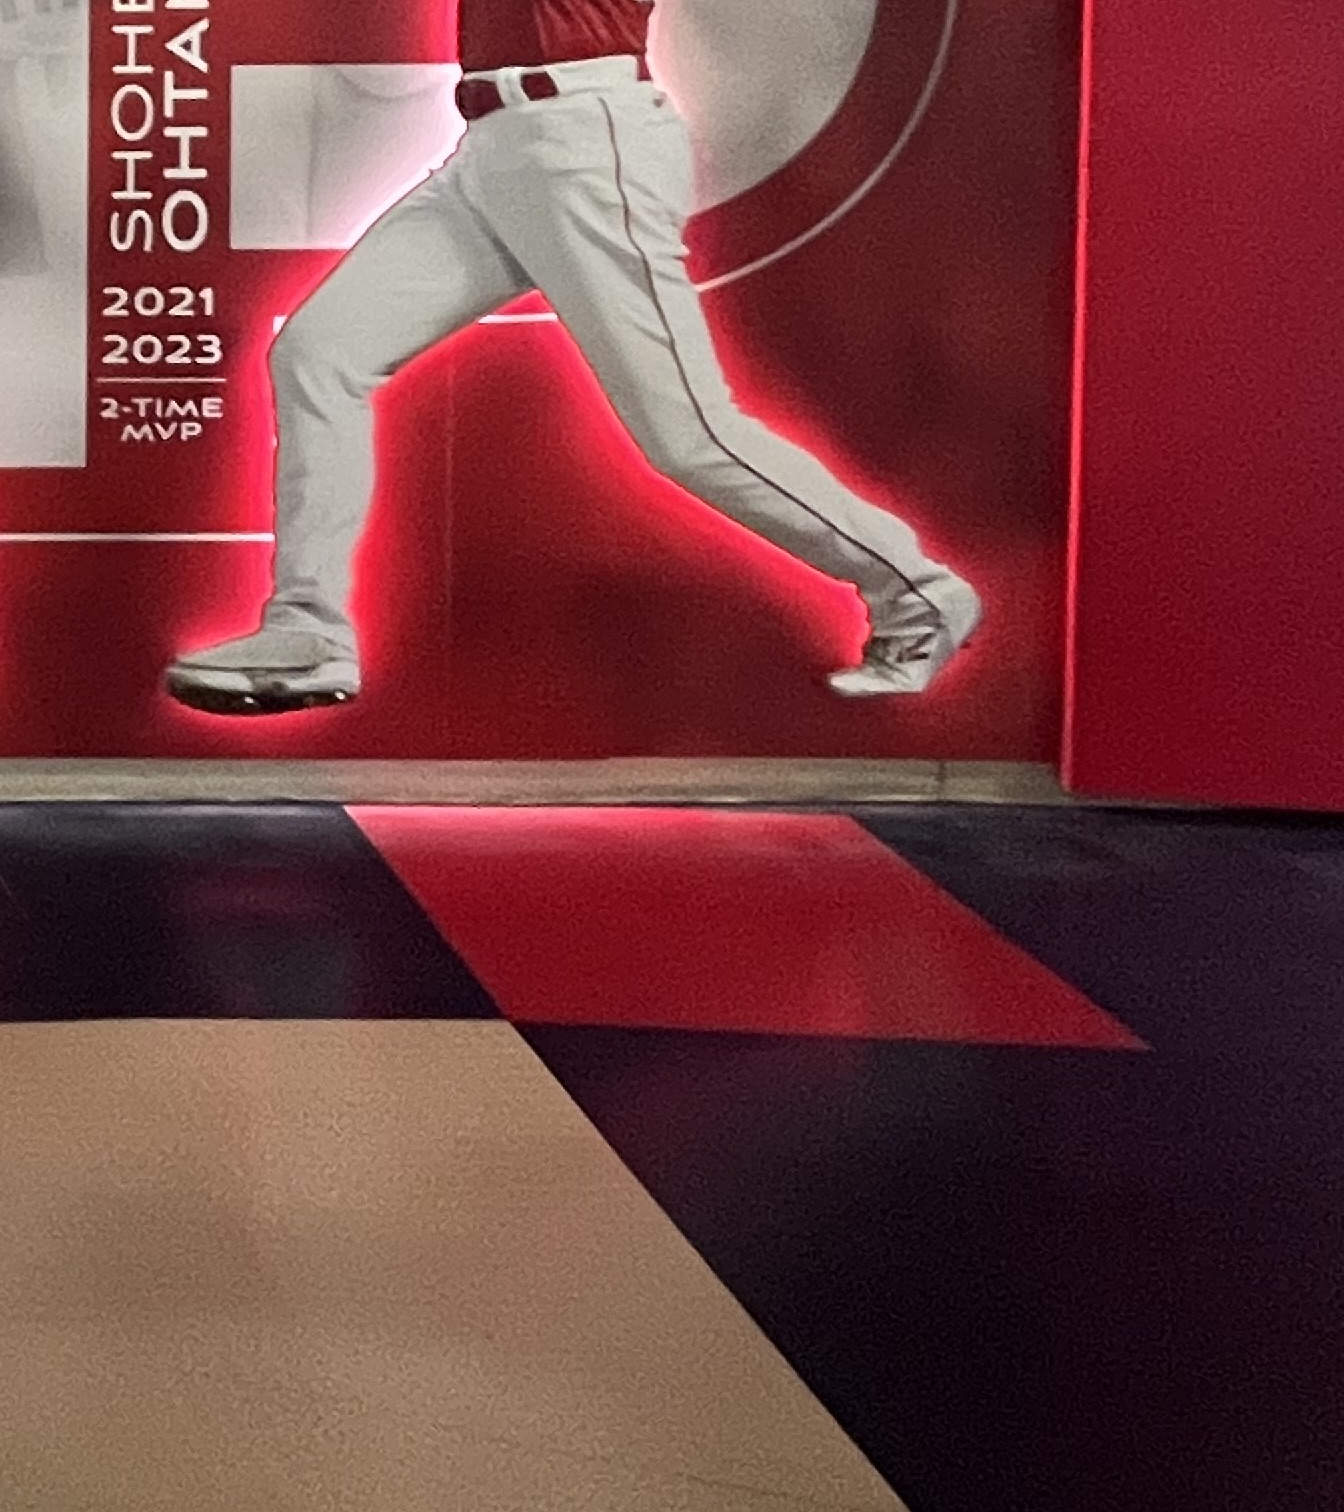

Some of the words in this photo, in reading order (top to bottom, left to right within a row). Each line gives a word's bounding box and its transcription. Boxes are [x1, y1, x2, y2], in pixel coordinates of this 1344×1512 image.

[102, 286, 214, 317] 2021
[102, 334, 223, 365] 2023
[99, 396, 224, 419] 2-TIME
[120, 421, 203, 443] MVP
